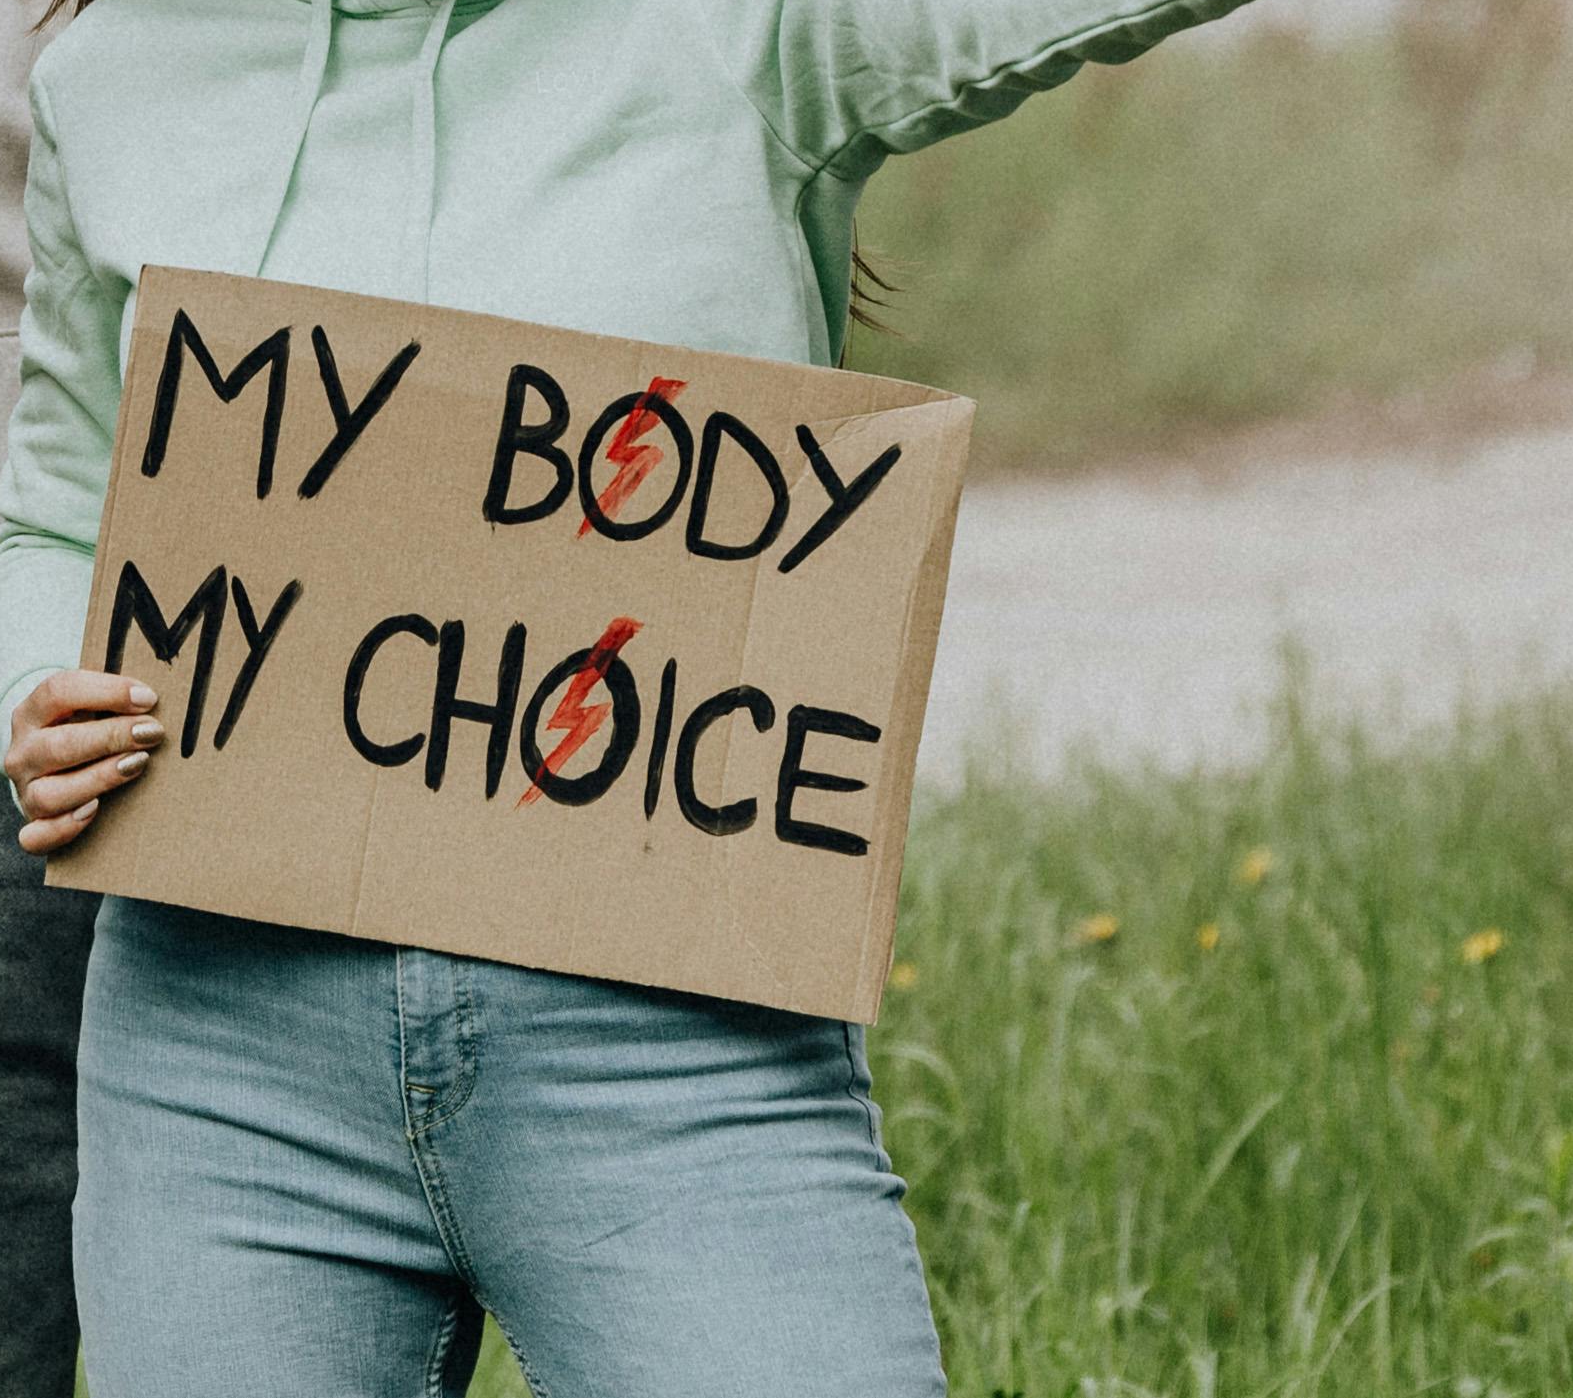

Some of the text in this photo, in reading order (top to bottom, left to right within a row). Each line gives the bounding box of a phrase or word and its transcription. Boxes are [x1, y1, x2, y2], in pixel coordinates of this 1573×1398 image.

[140, 307, 903, 575] MY BODY
[103, 559, 883, 857] MY CHOICE
